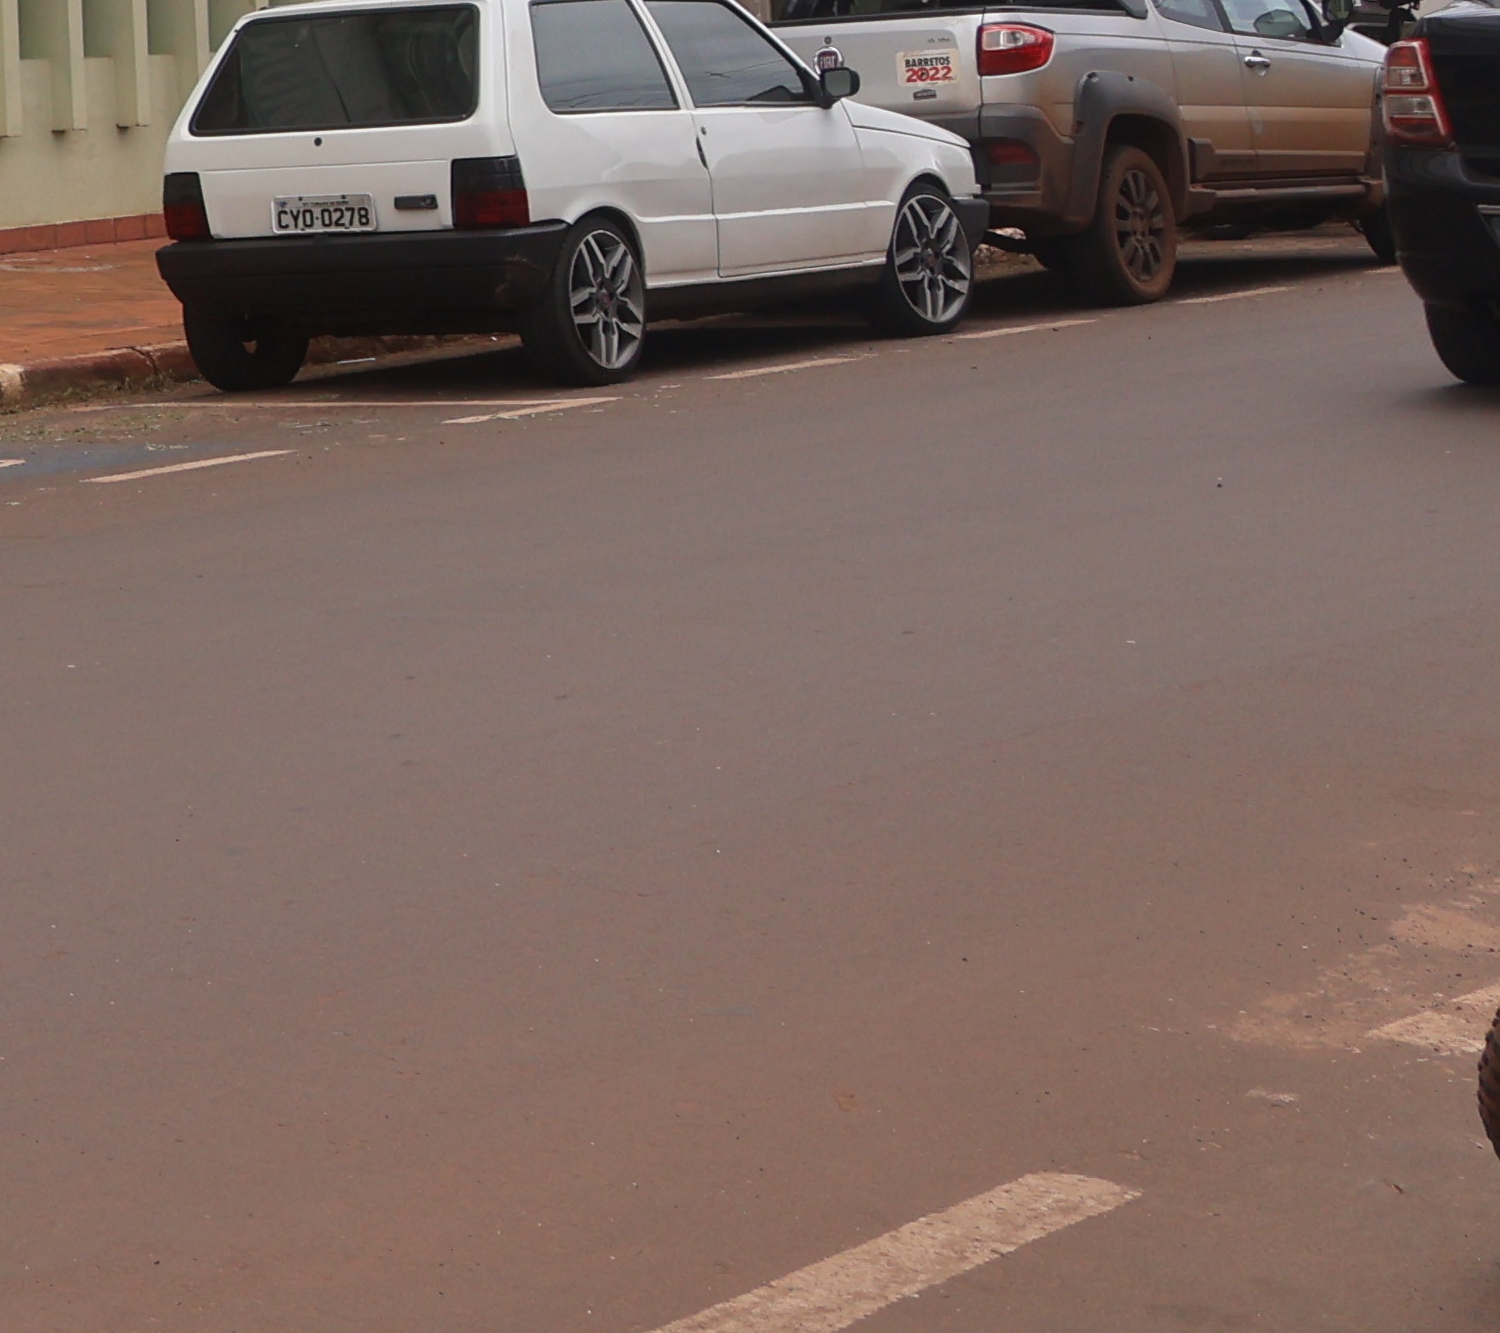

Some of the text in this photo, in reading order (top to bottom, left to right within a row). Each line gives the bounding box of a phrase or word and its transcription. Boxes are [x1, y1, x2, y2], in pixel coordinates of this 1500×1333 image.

[819, 55, 836, 70] FIAT
[904, 55, 951, 68] BARRETOS
[905, 66, 953, 83] 2022
